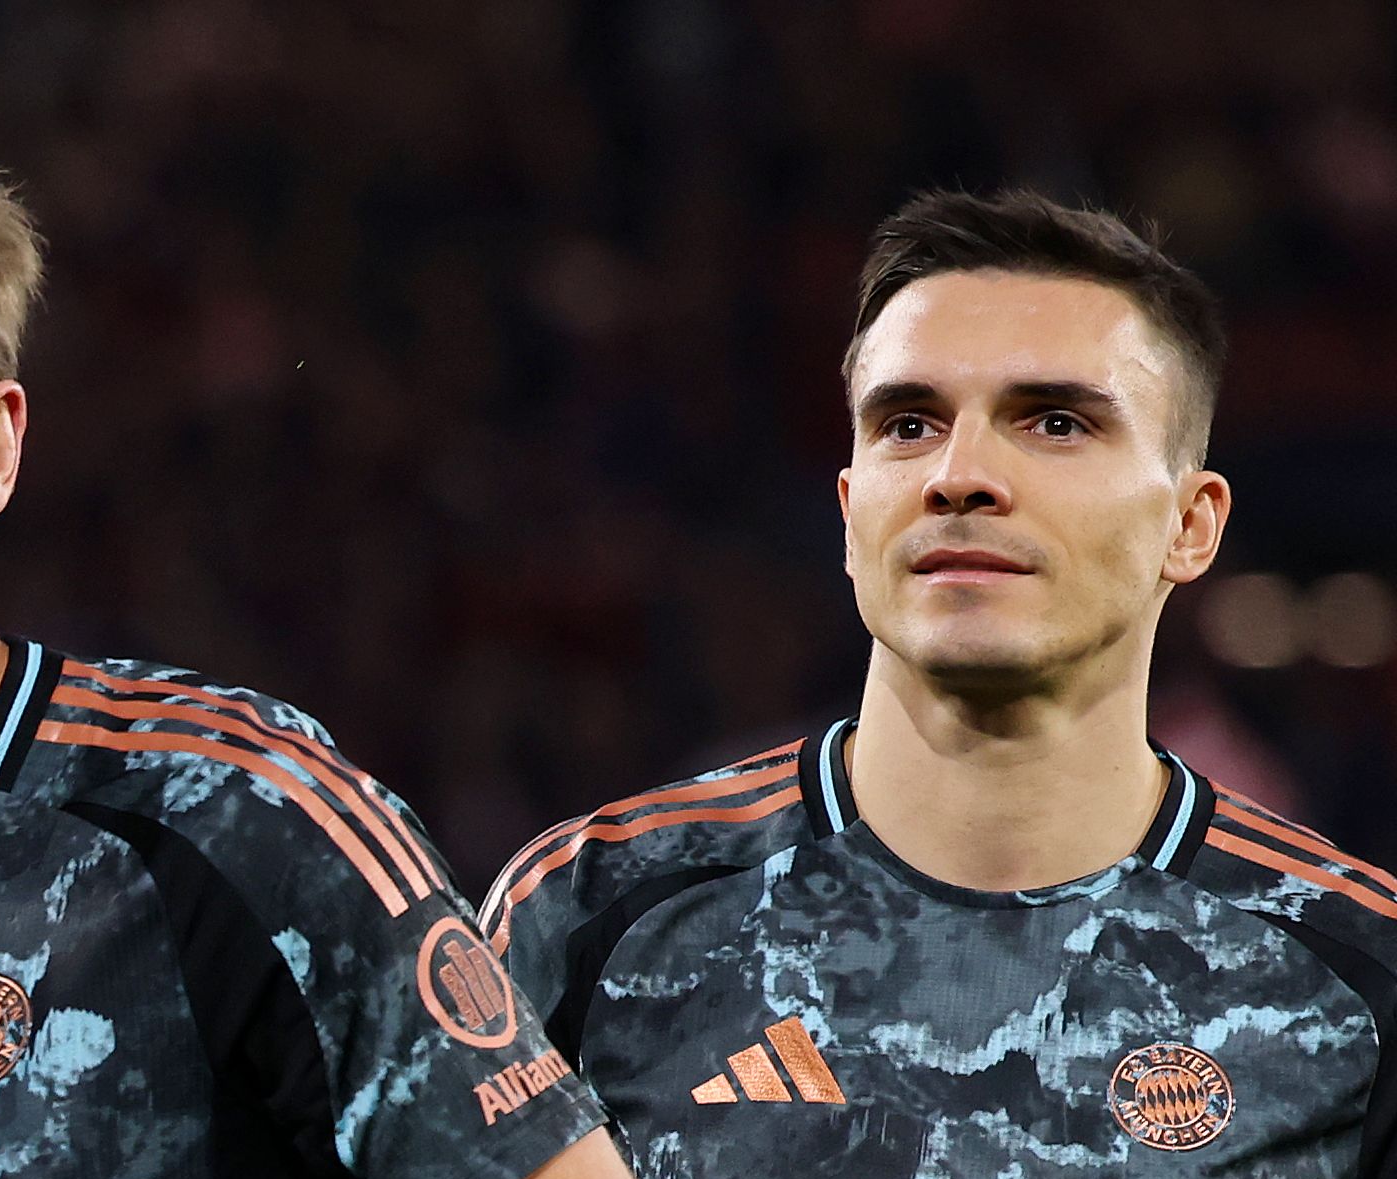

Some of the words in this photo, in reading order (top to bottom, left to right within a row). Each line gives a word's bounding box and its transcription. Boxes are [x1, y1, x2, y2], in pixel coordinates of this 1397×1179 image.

[1121, 1057, 1145, 1084] FC
[1148, 1049, 1225, 1095] BAYERN
[1118, 1100, 1222, 1145] MÜNCHEN
